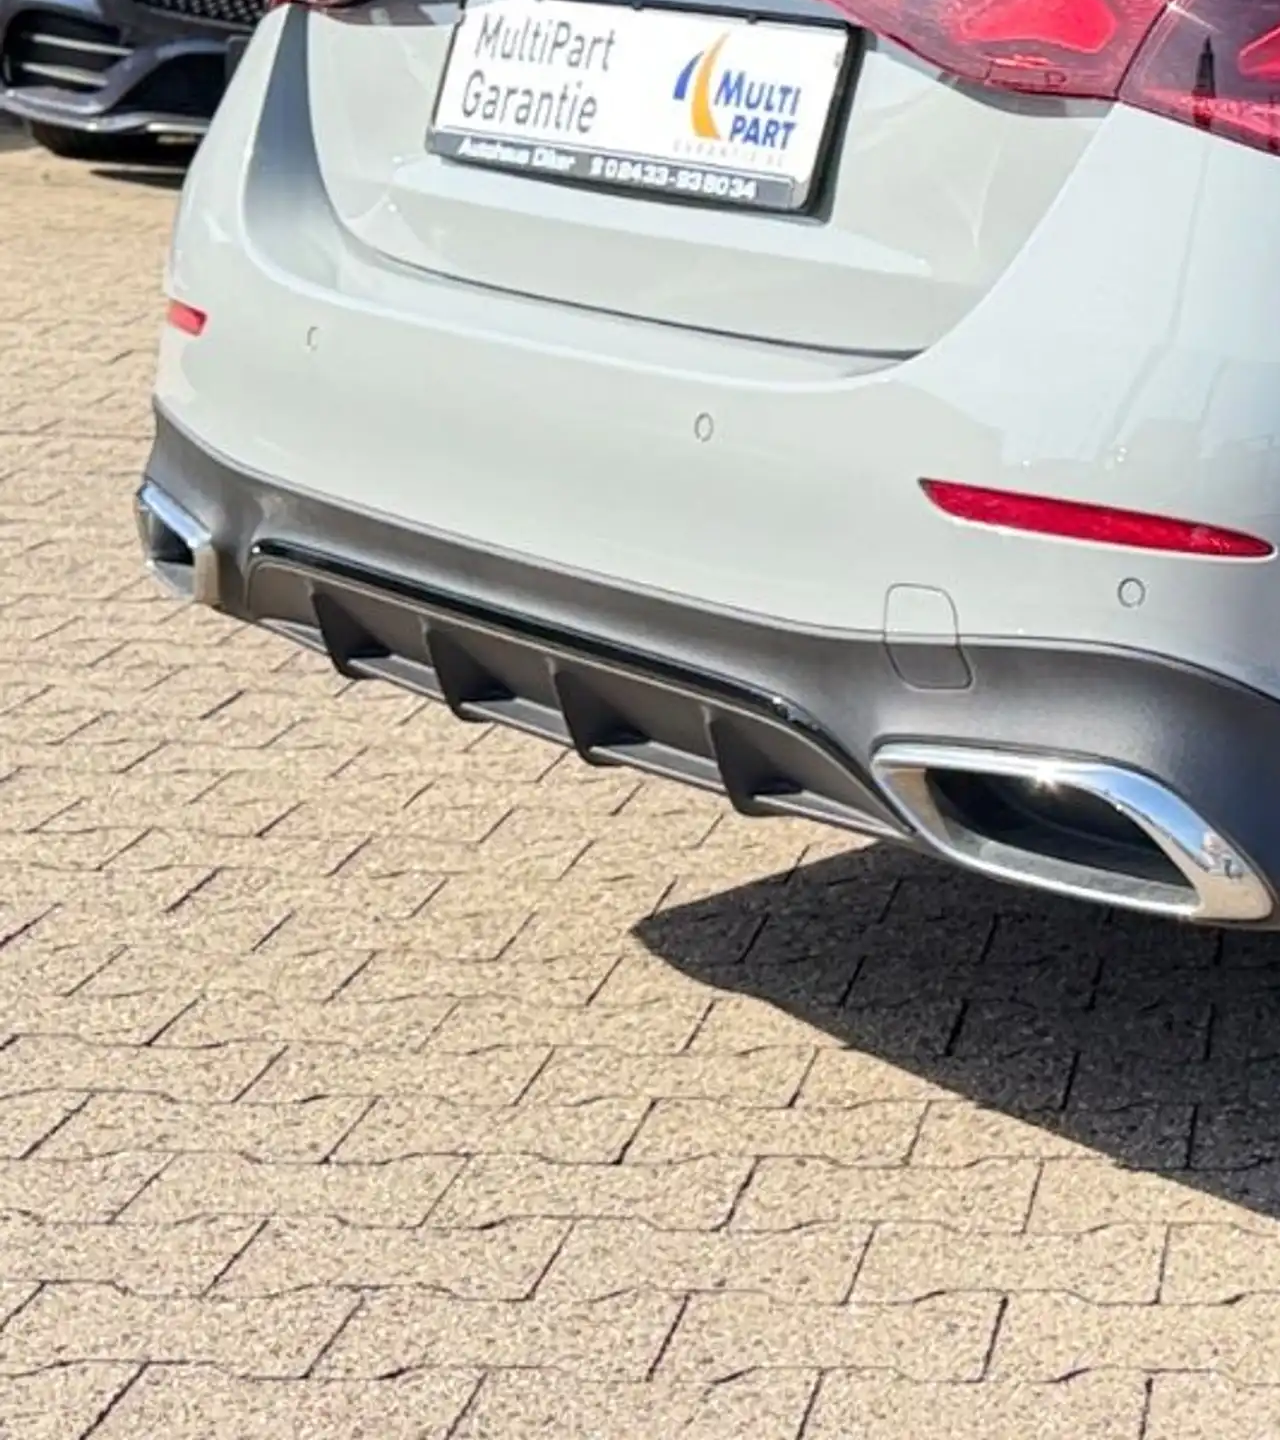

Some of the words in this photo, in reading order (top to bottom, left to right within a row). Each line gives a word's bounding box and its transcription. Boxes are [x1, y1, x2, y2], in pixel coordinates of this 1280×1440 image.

[474, 13, 616, 72] MultiPart
[462, 69, 598, 134] Garantie
[728, 114, 798, 150] PART
